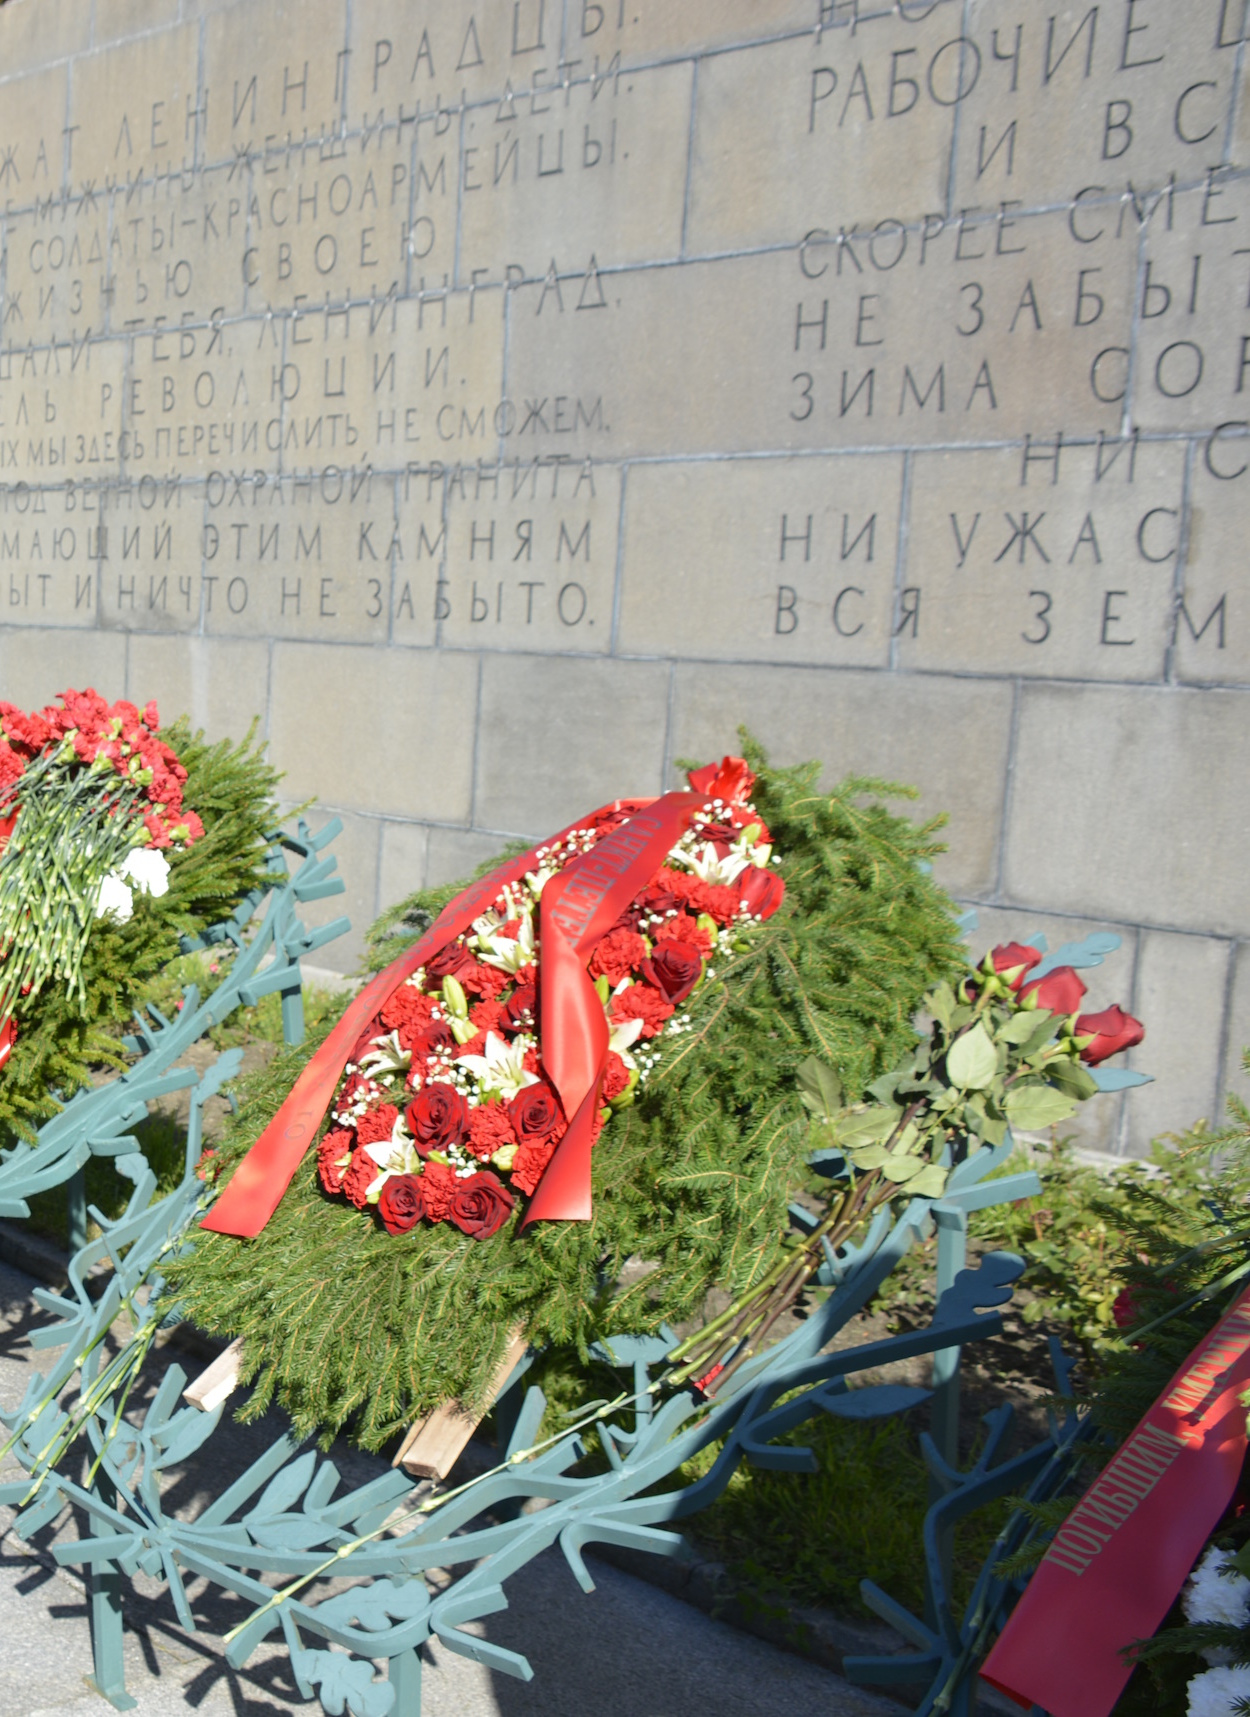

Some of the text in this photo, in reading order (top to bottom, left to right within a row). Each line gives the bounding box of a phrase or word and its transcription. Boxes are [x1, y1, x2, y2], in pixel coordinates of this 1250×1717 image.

[494, 50, 633, 123] ДЕТИ.
[808, 0, 1165, 134] РАБОЧИЕ
[976, 120, 1018, 181] И
[799, 163, 1239, 279] СКОРЕЕ СМЕ
[3, 260, 192, 324] ЖИЗНЬЮ
[241, 216, 435, 287] СВОЕЮ
[794, 295, 884, 351] НЕ
[101, 346, 467, 418] РЕВОЛЮЦИИ.
[789, 358, 998, 422] ЗИМА
[26, 436, 66, 467] МЫ
[74, 431, 145, 464] ЗДЕСЬ
[155, 413, 358, 459] ПЕРЕЧИСЛИТЬ
[376, 408, 420, 445] НЕ
[1020, 426, 1141, 487] НИ
[205, 452, 373, 508] ОХРАНОЙ
[405, 453, 596, 502] ГРАНИТА
[203, 523, 321, 561] ЭТИМ
[357, 519, 591, 562] КАМНЯМ
[779, 507, 1178, 568] НИ УЖАС
[75, 574, 92, 609] И
[117, 575, 249, 614] НИЧТО
[280, 577, 337, 617] НЕ
[366, 578, 595, 627] ЗАБЫТО.
[774, 584, 1228, 650] ВСЯ ЗЕМ
